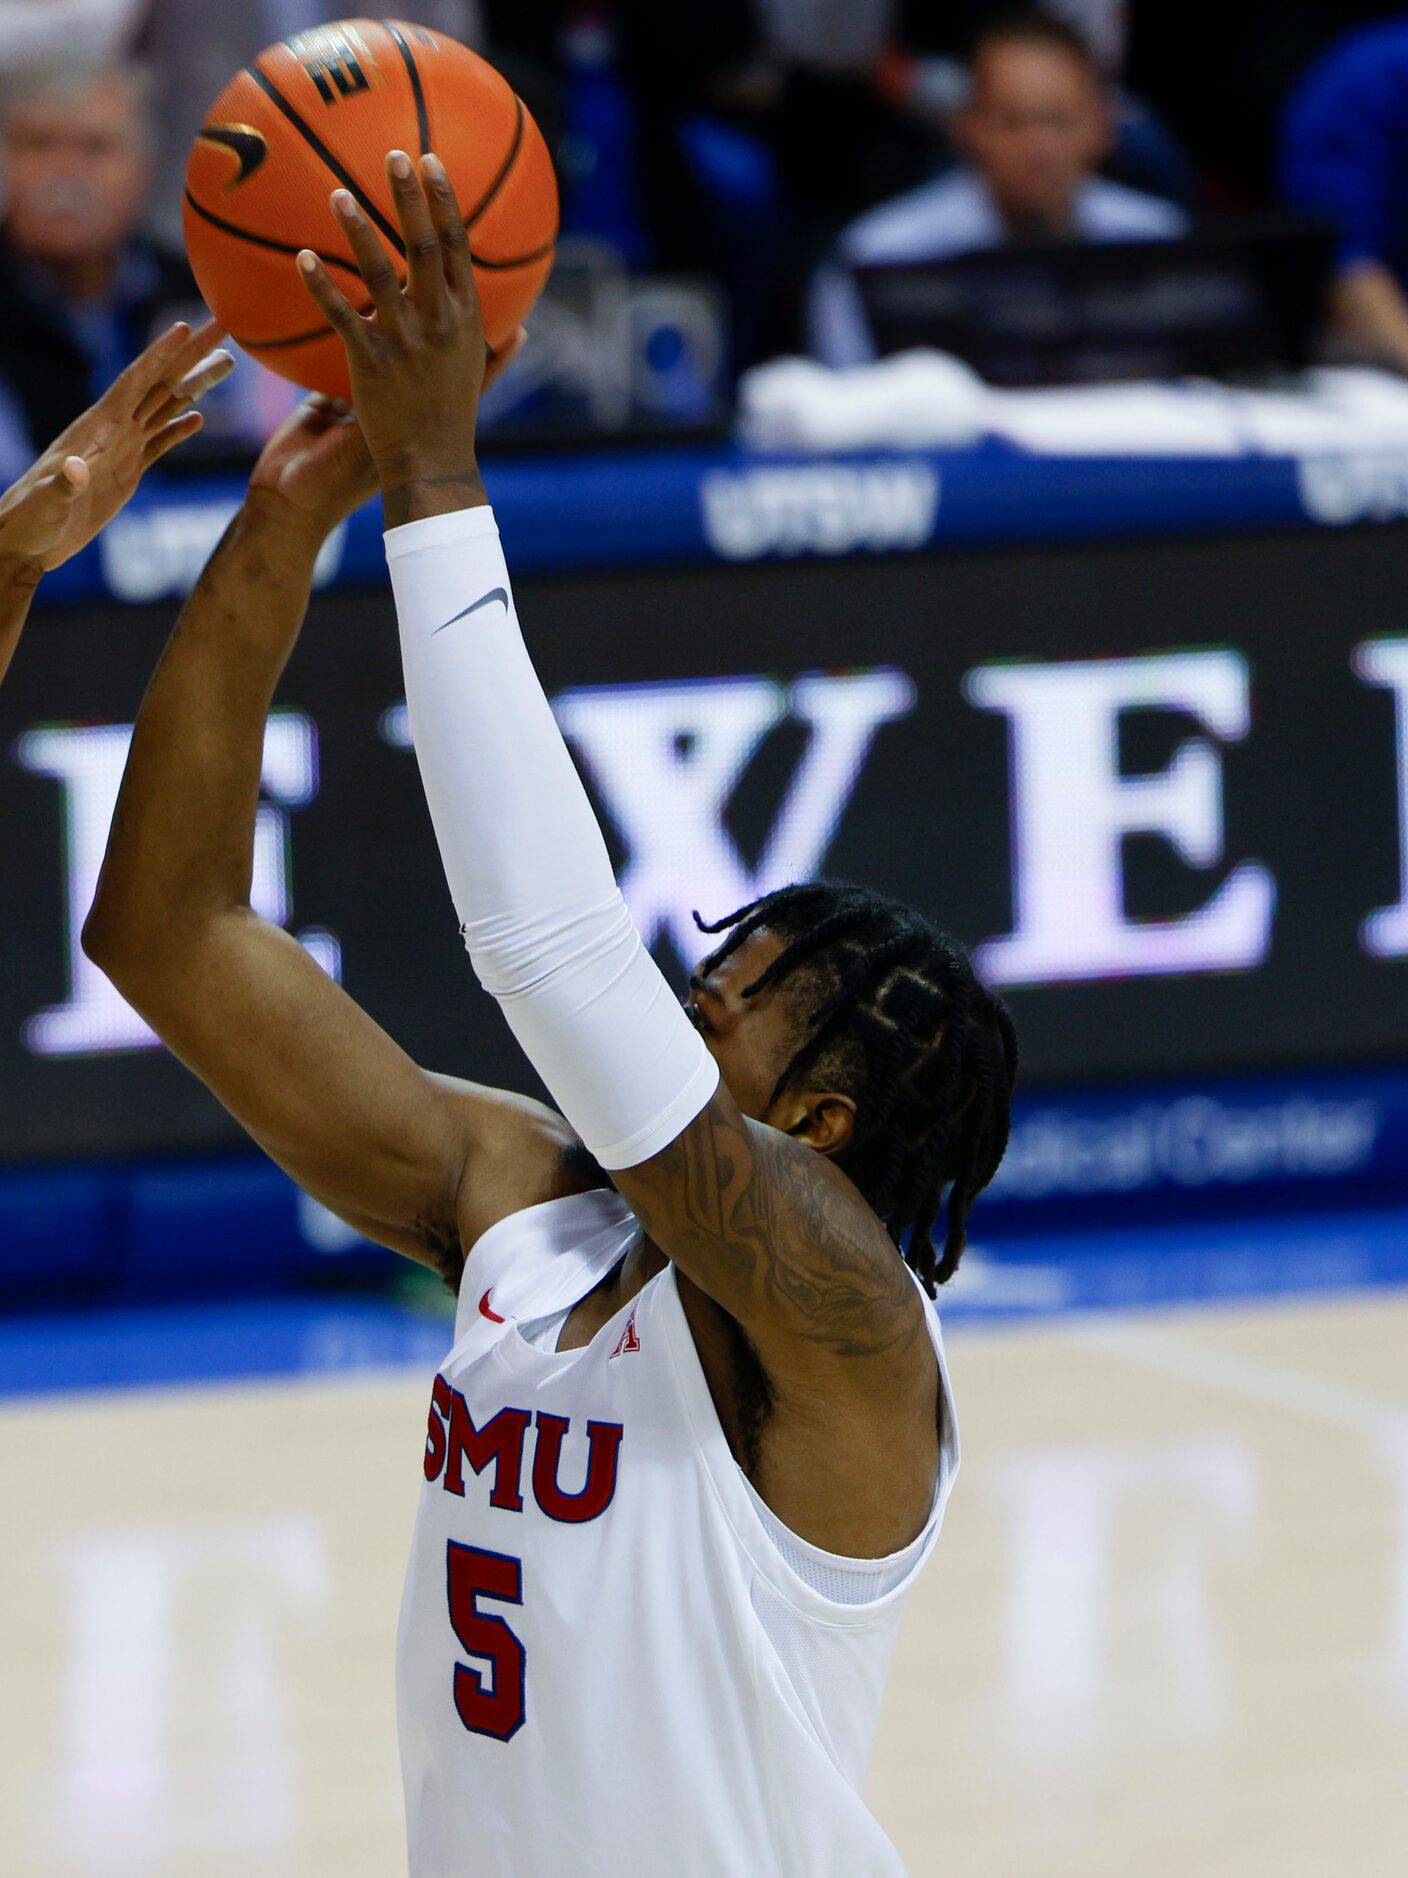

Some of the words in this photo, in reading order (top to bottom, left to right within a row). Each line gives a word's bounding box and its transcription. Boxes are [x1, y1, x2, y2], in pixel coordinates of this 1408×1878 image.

[700, 464, 938, 561] UTSW
[423, 1373, 623, 1524] SMU
[447, 1538, 526, 1743] 5
